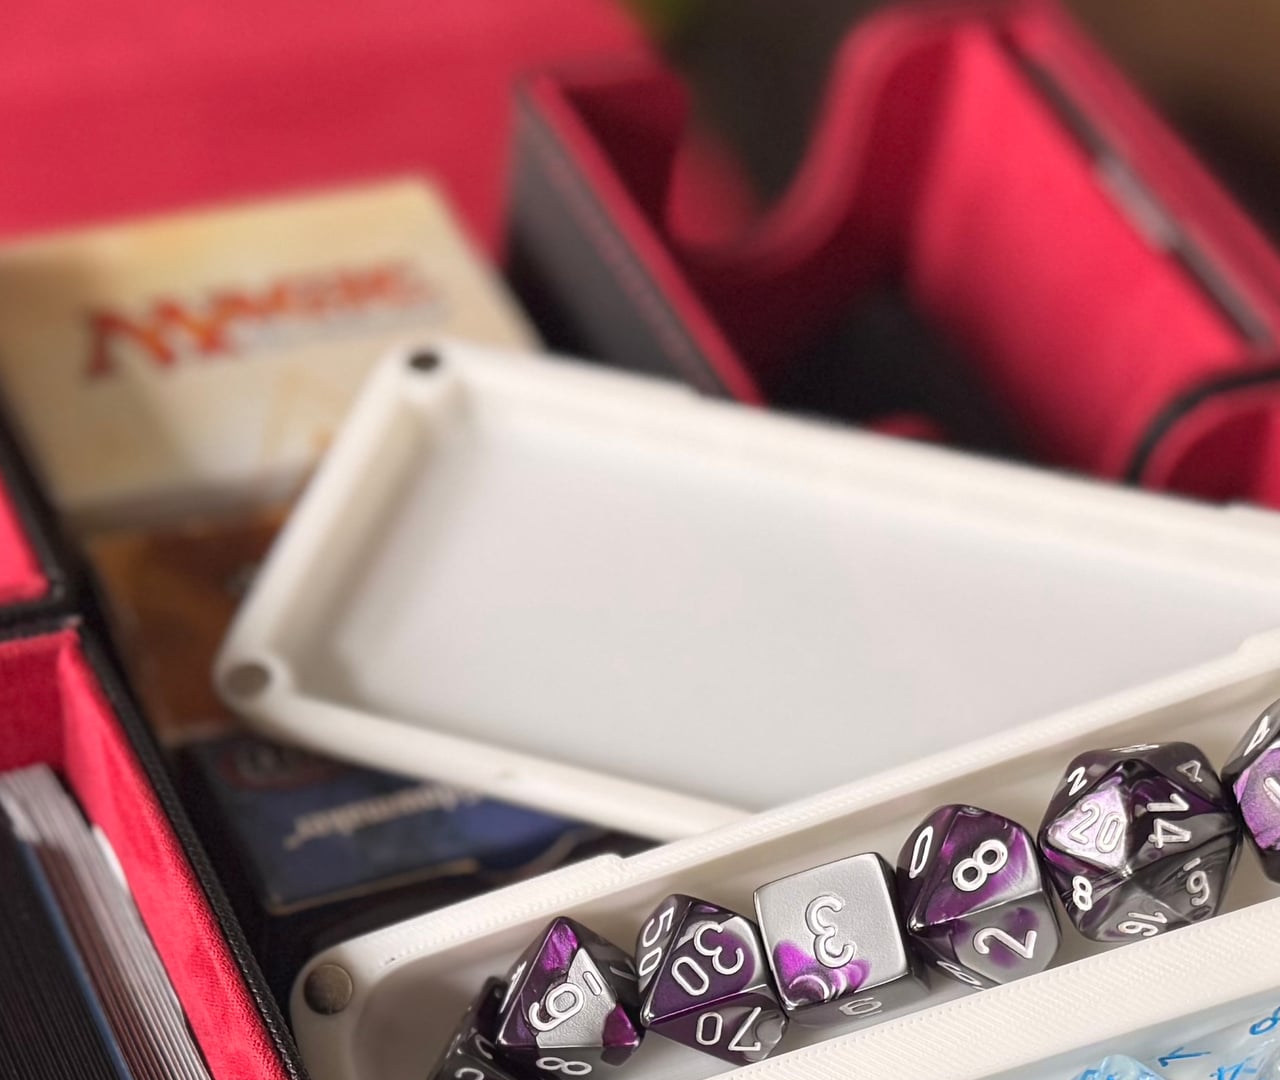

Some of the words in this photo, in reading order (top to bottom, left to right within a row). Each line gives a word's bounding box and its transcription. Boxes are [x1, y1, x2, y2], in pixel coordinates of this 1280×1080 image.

[1066, 766, 1088, 796] 2
[1176, 760, 1203, 783] 4
[1068, 802, 1123, 853] 20
[952, 839, 1008, 892] 8
[1072, 875, 1093, 911] 8
[639, 907, 674, 976] 50
[805, 893, 857, 968] 3
[973, 928, 1037, 959] 2
[1117, 911, 1168, 937] 16
[671, 921, 744, 996] 30
[695, 1007, 761, 1051] 70
[535, 1056, 593, 1076] 8
